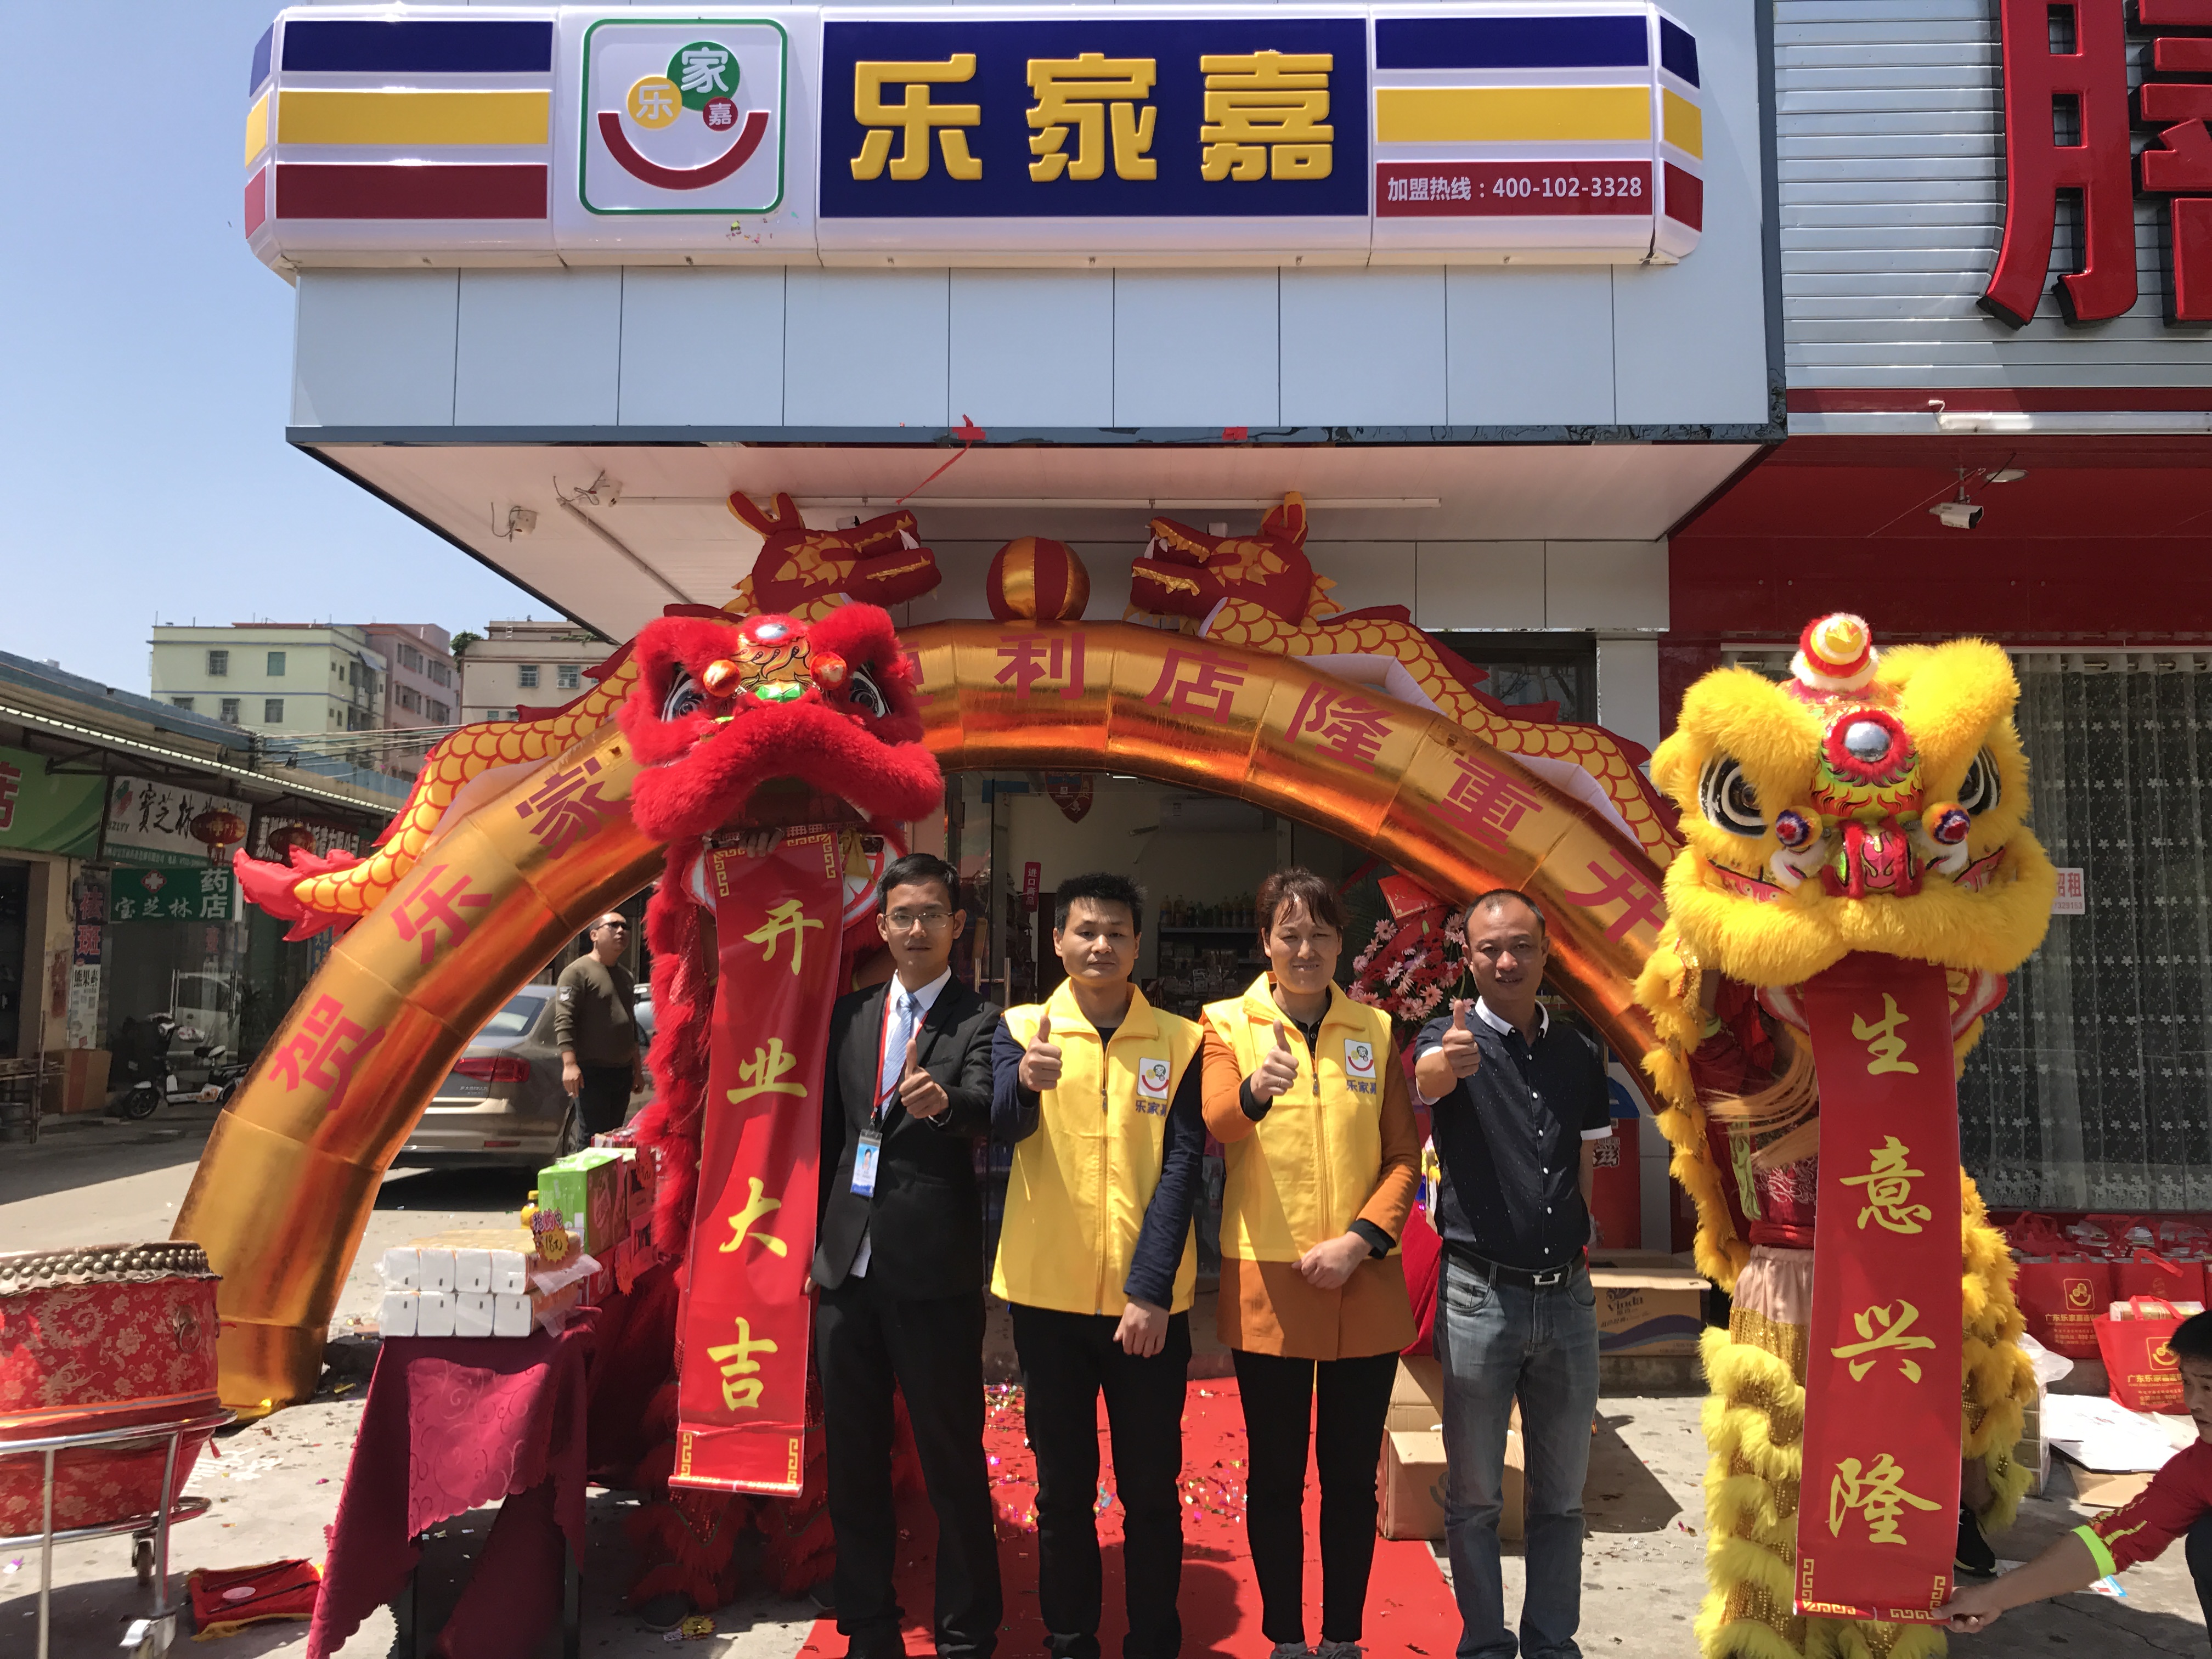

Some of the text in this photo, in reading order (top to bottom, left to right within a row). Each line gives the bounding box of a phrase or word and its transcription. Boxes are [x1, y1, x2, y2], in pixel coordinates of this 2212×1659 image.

[850, 50, 1334, 182] 乐家嘉
[115, 898, 191, 921] 宝芝林
[200, 869, 228, 919] 药店
[1026, 868, 1037, 905] 进口商品
[708, 899, 824, 1410] 开业大吉
[1830, 992, 1943, 1545] 生意兴隆
